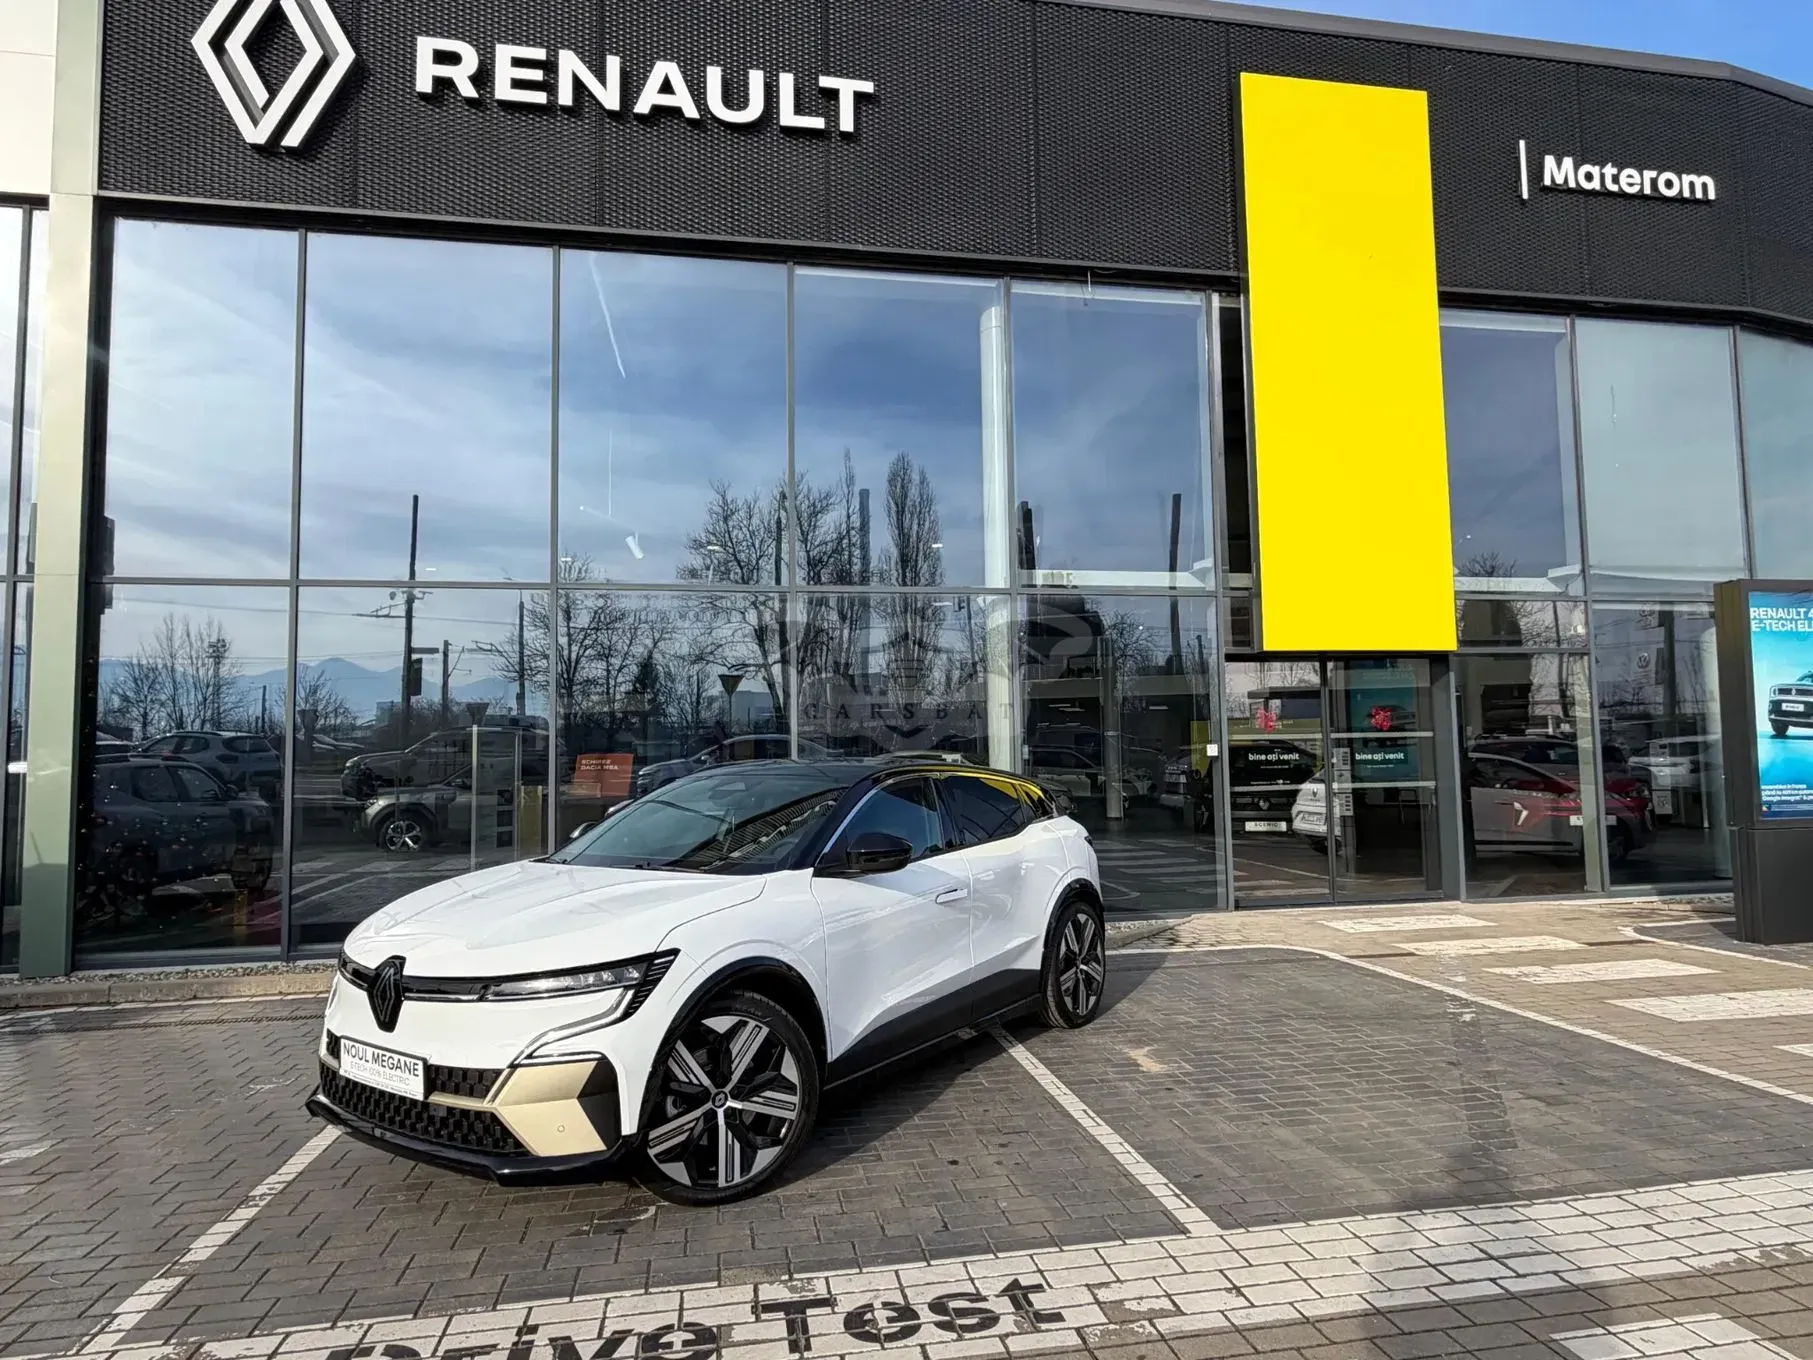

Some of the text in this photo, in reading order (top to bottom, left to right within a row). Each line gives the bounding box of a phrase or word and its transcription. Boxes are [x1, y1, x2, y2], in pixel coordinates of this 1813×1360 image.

[415, 36, 875, 133] RENAULT
[1543, 155, 1716, 201] Materom
[1750, 607, 1807, 619] RENAULT
[1751, 620, 1813, 632] E-TECH EL
[1249, 753, 1266, 761] bine
[1279, 752, 1300, 761] venit
[1355, 752, 1373, 760] bine
[1384, 752, 1405, 760] venit
[343, 1041, 420, 1078] NOUL MEGANE
[382, 1070, 411, 1087] ELECTRIC
[751, 1277, 1067, 1353] Test
